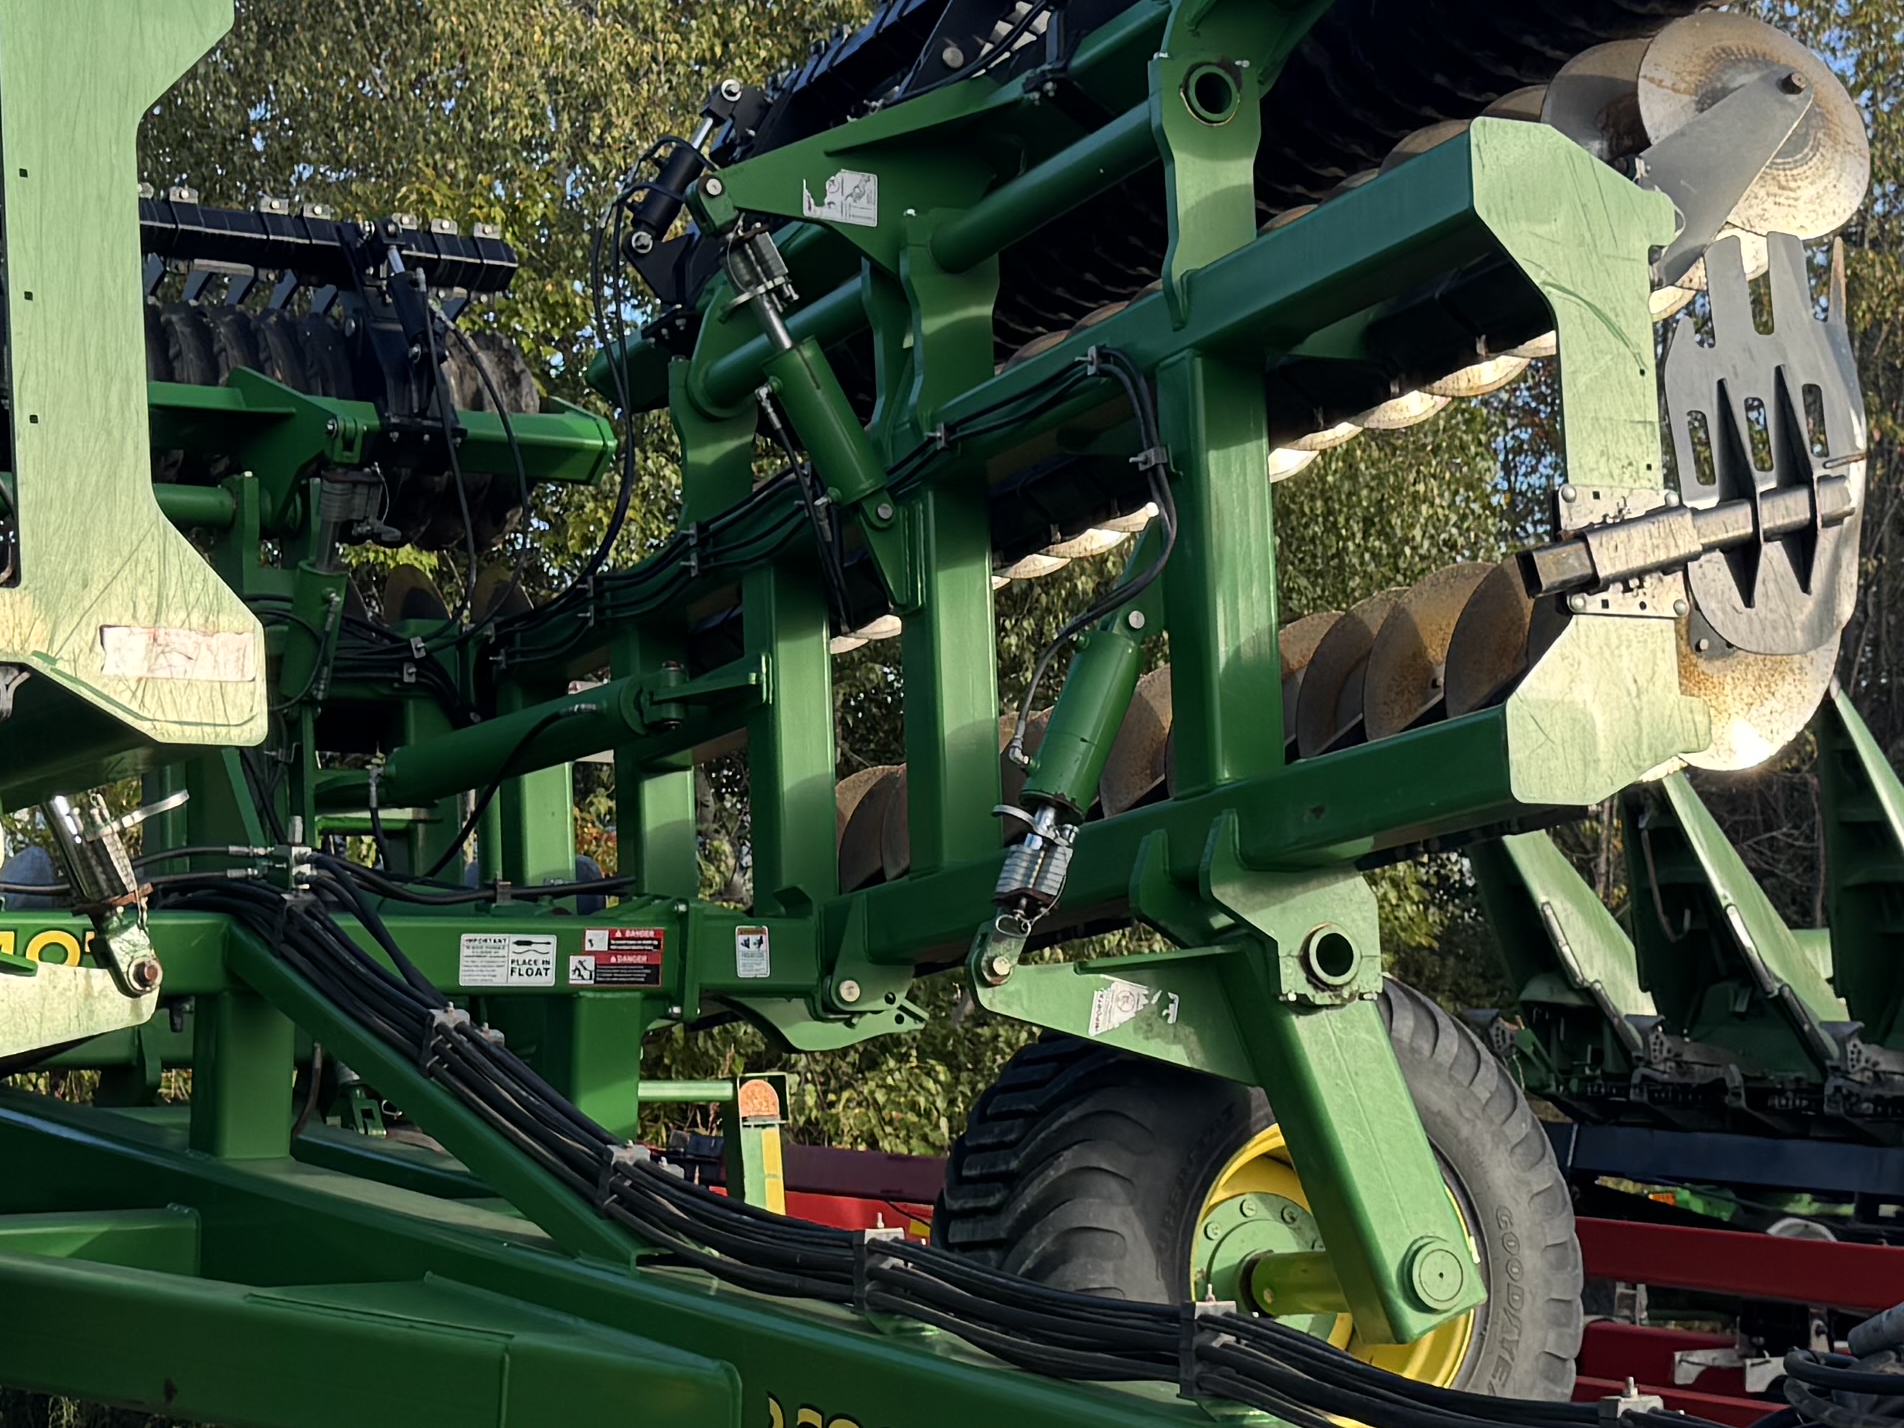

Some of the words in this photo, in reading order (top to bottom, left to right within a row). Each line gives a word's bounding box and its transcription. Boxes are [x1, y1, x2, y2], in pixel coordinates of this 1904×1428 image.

[625, 929, 655, 938] DANGER
[542, 958, 551, 966] IN
[616, 955, 648, 964] DANGER
[510, 967, 551, 977] FLOAT
